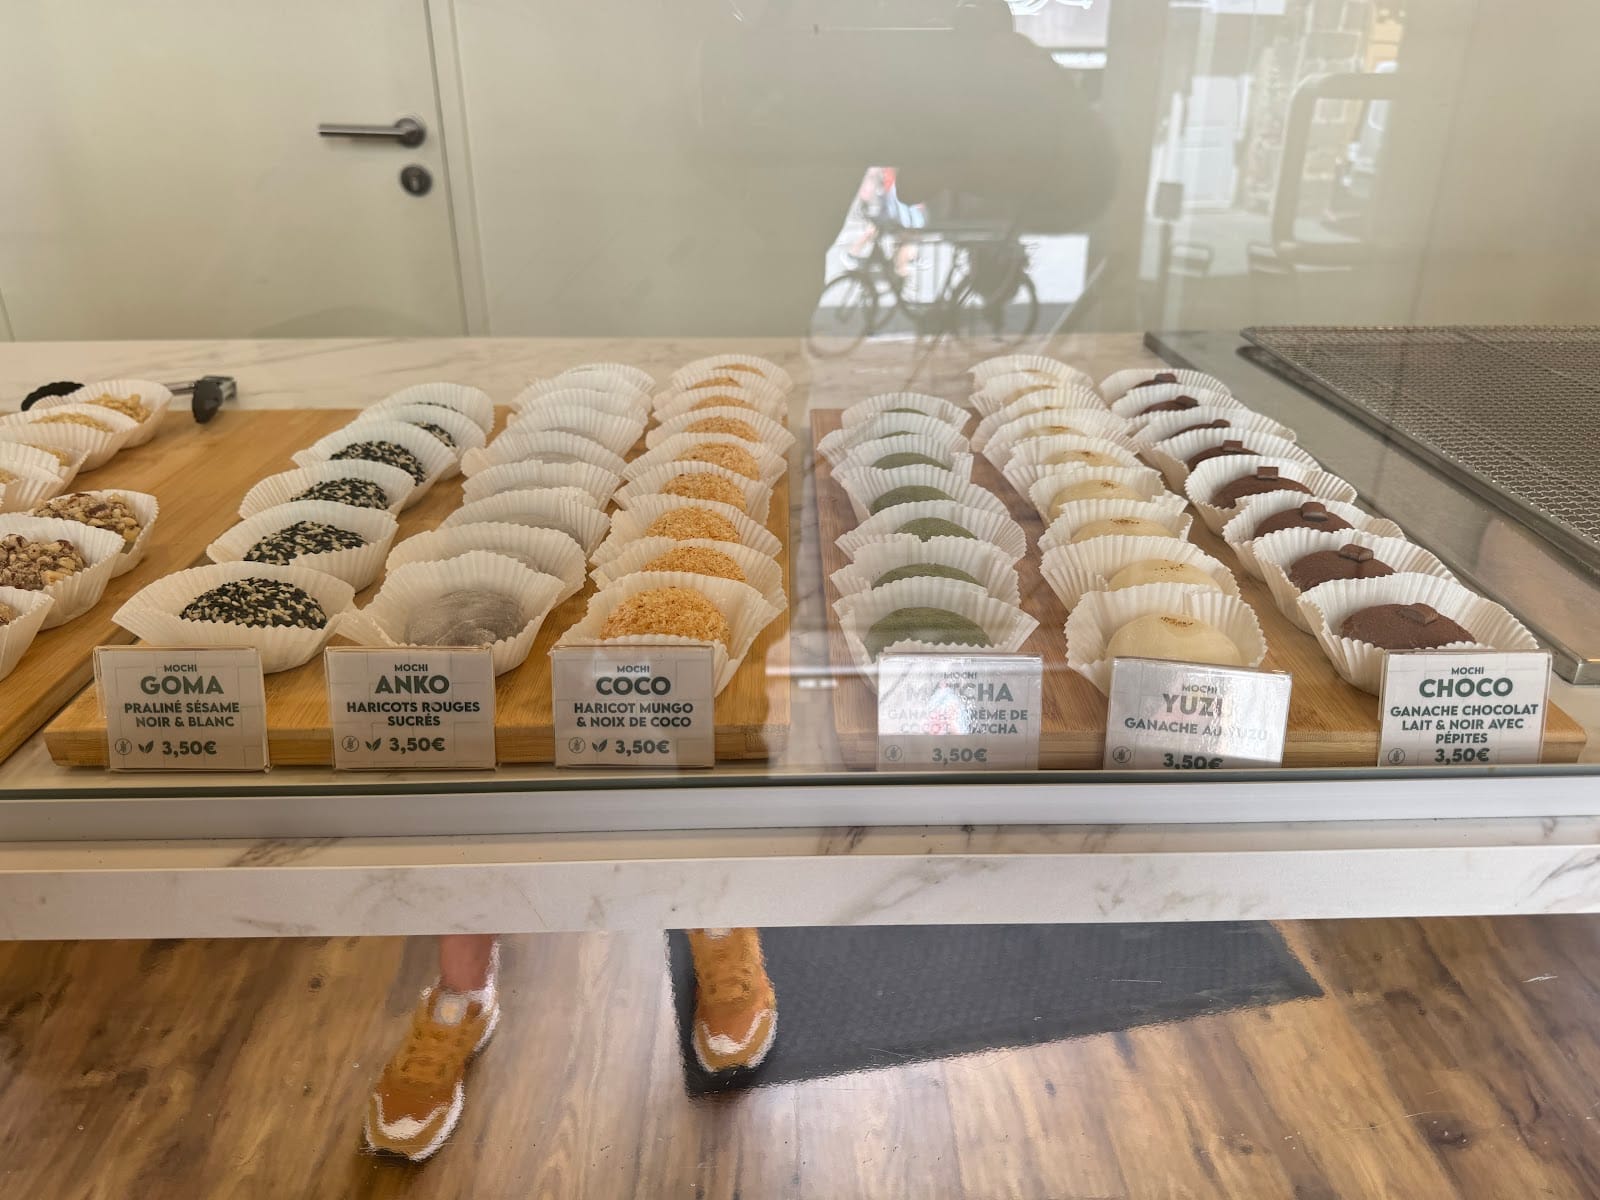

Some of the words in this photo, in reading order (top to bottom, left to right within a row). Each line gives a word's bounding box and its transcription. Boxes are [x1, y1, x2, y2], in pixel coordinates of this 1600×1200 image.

[164, 664, 197, 672] MOCHI
[617, 665, 649, 673] MOCHI
[1451, 667, 1484, 675] MOCHI
[944, 671, 977, 679] MOCHI
[140, 675, 224, 695] GOMA
[375, 675, 449, 694] ANKO
[596, 677, 671, 695] COCO
[1182, 684, 1217, 694] MOCHI
[1419, 678, 1513, 698] CHOCO
[124, 700, 182, 713] PRALINÉ
[186, 700, 239, 713] SÉSAME
[347, 702, 417, 712] HARICOTS
[422, 702, 480, 712] ROUGES
[574, 703, 635, 713] HARICOT
[640, 703, 693, 713] MUNGO
[1390, 706, 1458, 717] GANACHE
[1463, 704, 1538, 715] CHOCOLAT
[136, 716, 170, 727] NOIR
[175, 717, 184, 727] &
[189, 717, 235, 727] BLANC
[388, 713, 440, 726] SUCRÉS
[1010, 710, 1028, 720] DE
[576, 717, 586, 727] &
[591, 717, 625, 727] NOIX
[629, 717, 647, 727] DE
[651, 717, 692, 727] COCO
[1125, 718, 1198, 734] GANACHE
[1402, 720, 1432, 731] LAIT
[1436, 720, 1445, 730] &
[1450, 719, 1484, 730] NOIR
[1488, 718, 1524, 729] AVEC
[1436, 731, 1488, 744] PÉPITES
[162, 741, 217, 758] 3,50€
[389, 737, 445, 754] 3,50€
[615, 740, 669, 756] 3,50€
[932, 748, 987, 765] 3,50€
[1434, 748, 1490, 765] 3,50€
